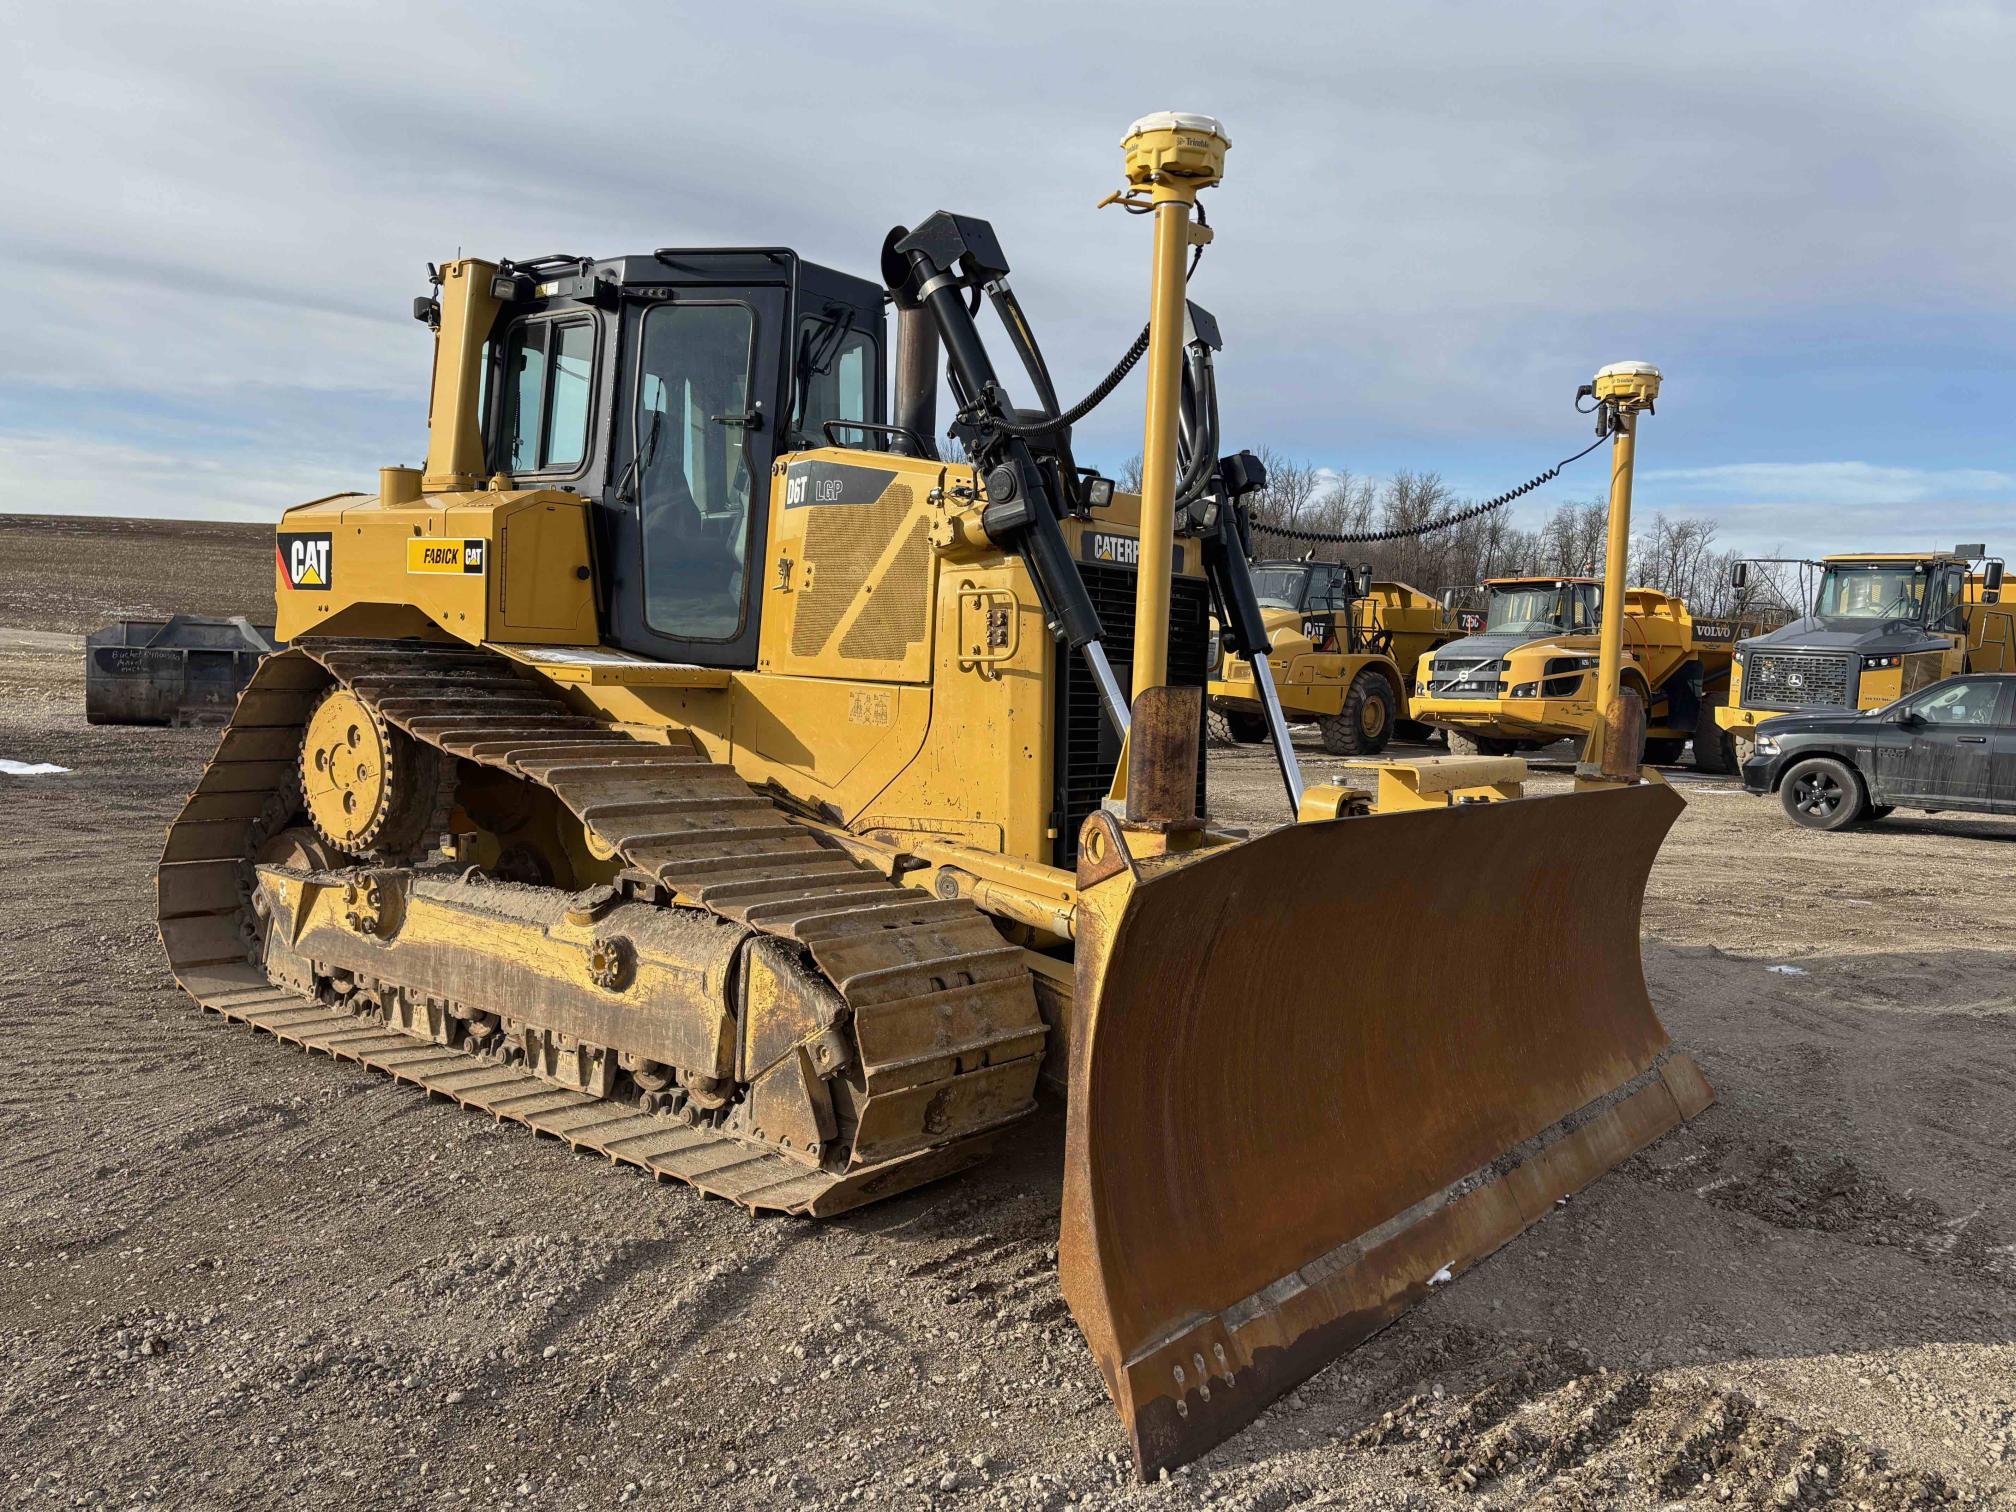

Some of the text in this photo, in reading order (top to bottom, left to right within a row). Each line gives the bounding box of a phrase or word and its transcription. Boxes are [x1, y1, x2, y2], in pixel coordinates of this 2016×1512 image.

[1186, 138, 1209, 148] Trimble
[787, 476, 843, 504] D6T LGP
[423, 548, 482, 565] FABICK CAT
[1094, 534, 1140, 564] CATERP
[291, 540, 330, 584] CAT
[1303, 621, 1326, 645] CAT
[1696, 625, 1731, 638] VOLVO
